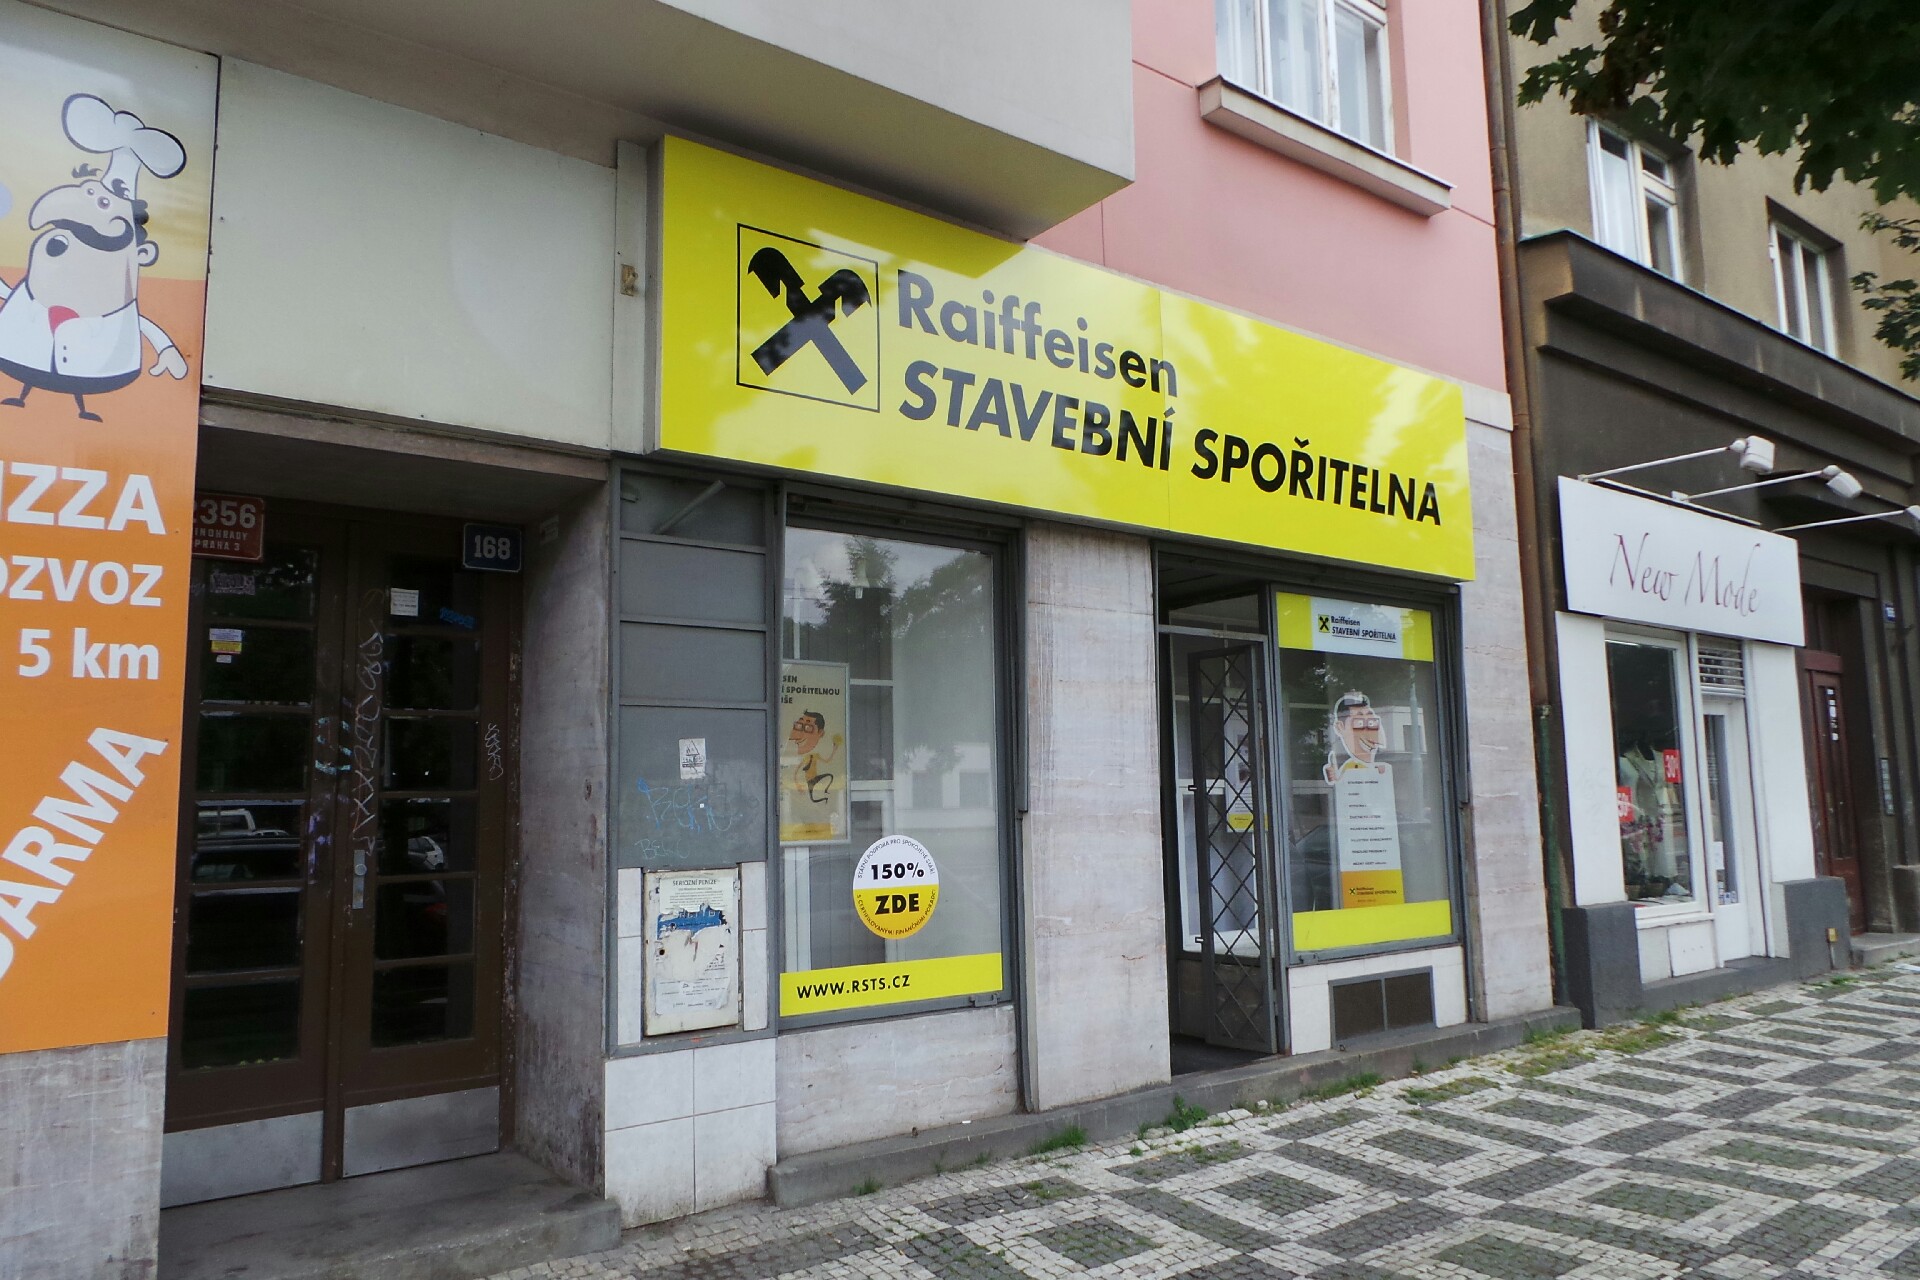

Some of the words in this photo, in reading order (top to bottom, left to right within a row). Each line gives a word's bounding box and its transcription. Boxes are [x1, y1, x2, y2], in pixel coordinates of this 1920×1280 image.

[898, 269, 1178, 397] Raiffeisen
[900, 360, 1173, 472] STAVEBNÍ
[1191, 429, 1441, 526] SPOŘITELNA
[0, 460, 166, 535] ZZA
[194, 499, 256, 529] 356
[194, 539, 230, 551] PRAHA
[234, 542, 240, 551] 3
[474, 534, 511, 560] 168
[0, 555, 163, 607] ZVOZ
[1610, 532, 1680, 601] New
[1685, 543, 1761, 617] Mode
[1331, 616, 1361, 626] Raiffeisen
[1332, 626, 1360, 637] STAVEBNÍ
[19, 628, 50, 678] 5
[72, 627, 159, 680] km
[786, 684, 840, 696] SPOŘITELNOU
[867, 841, 890, 860] PODPORA
[871, 862, 925, 880] 150%
[875, 893, 920, 916] ZDE
[797, 974, 911, 999] WWW.RSTS.CZ
